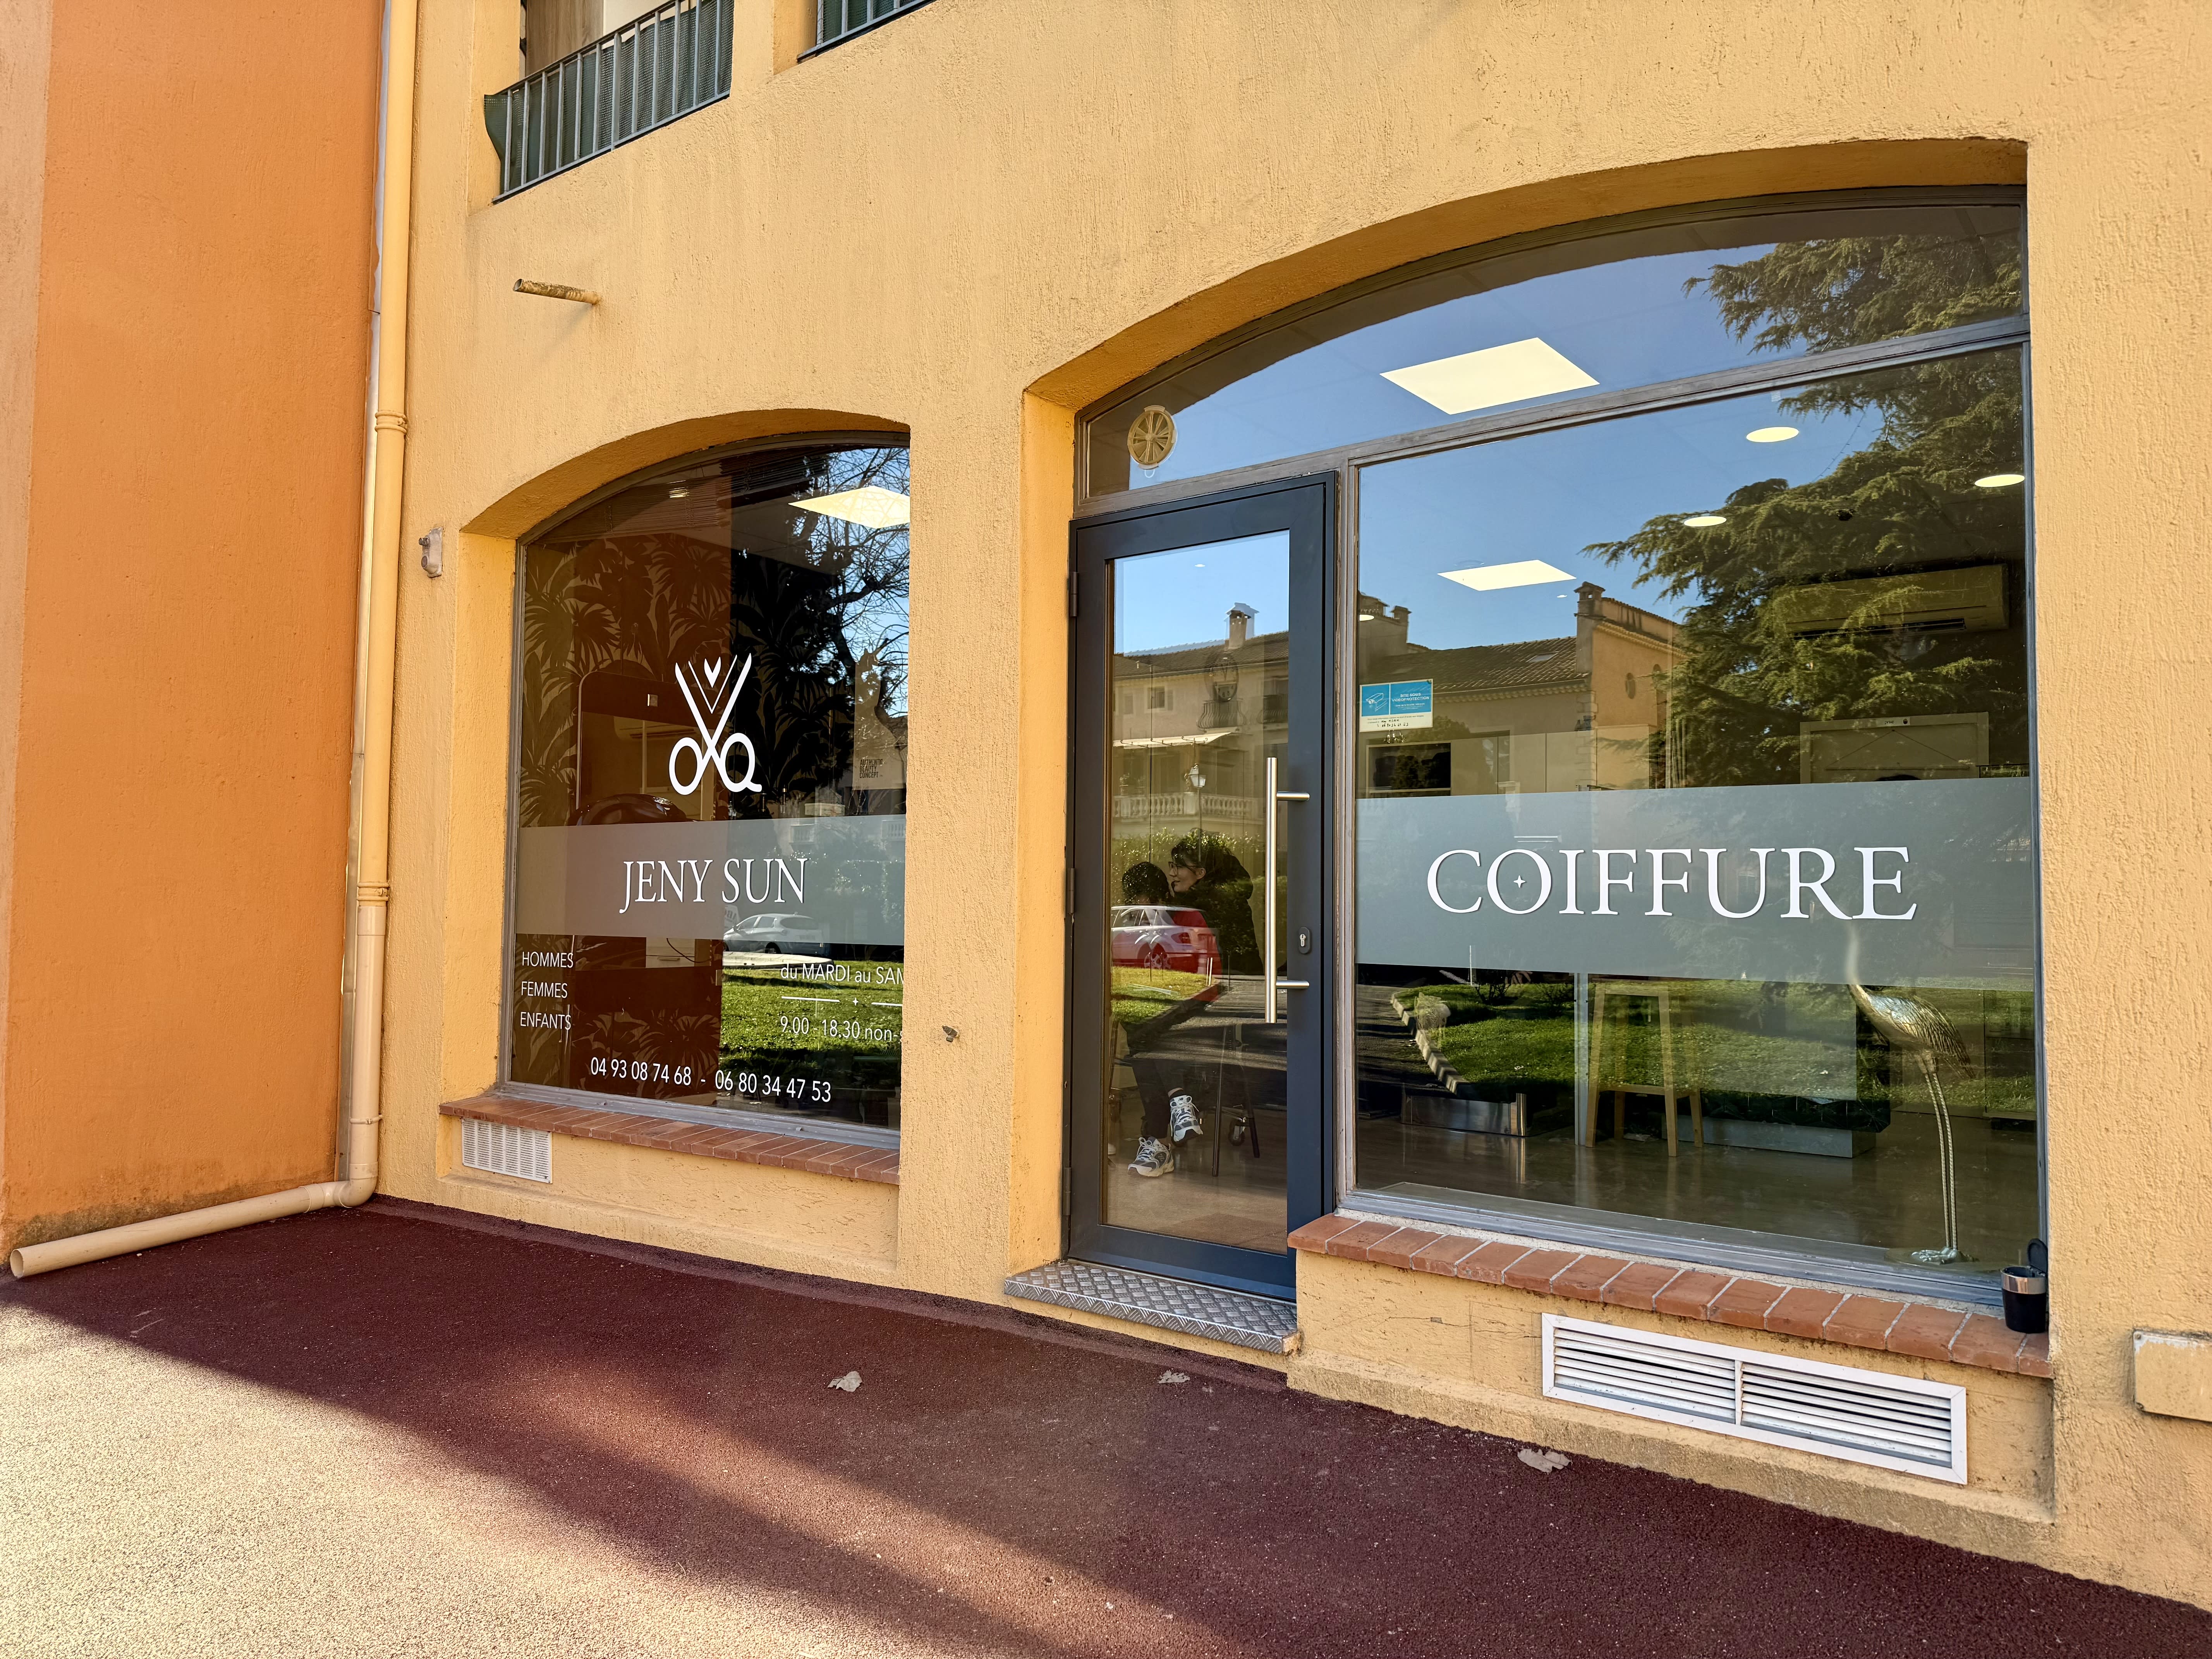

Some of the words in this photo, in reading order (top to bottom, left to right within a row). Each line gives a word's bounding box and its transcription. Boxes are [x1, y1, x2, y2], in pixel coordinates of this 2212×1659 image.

[619, 859, 714, 914] JENY
[721, 858, 808, 904] SUN
[1426, 847, 1917, 921] COIFFURE
[522, 951, 574, 968] HOMMES
[780, 963, 797, 979] du
[802, 963, 850, 982] MARDI
[855, 970, 871, 983] au
[521, 981, 568, 998] FEMMES
[520, 1012, 571, 1030] ENFANTS
[780, 1015, 809, 1035] 9.00
[821, 1019, 860, 1039] 18.30
[591, 1056, 607, 1076] 04
[611, 1059, 627, 1079] 93
[631, 1061, 648, 1081] 08
[653, 1063, 670, 1083] 74
[674, 1065, 691, 1086] 68
[715, 1070, 733, 1091] 06
[738, 1072, 757, 1093] 80
[762, 1075, 781, 1096] 34
[786, 1078, 806, 1099] 47
[811, 1080, 831, 1103] 53
